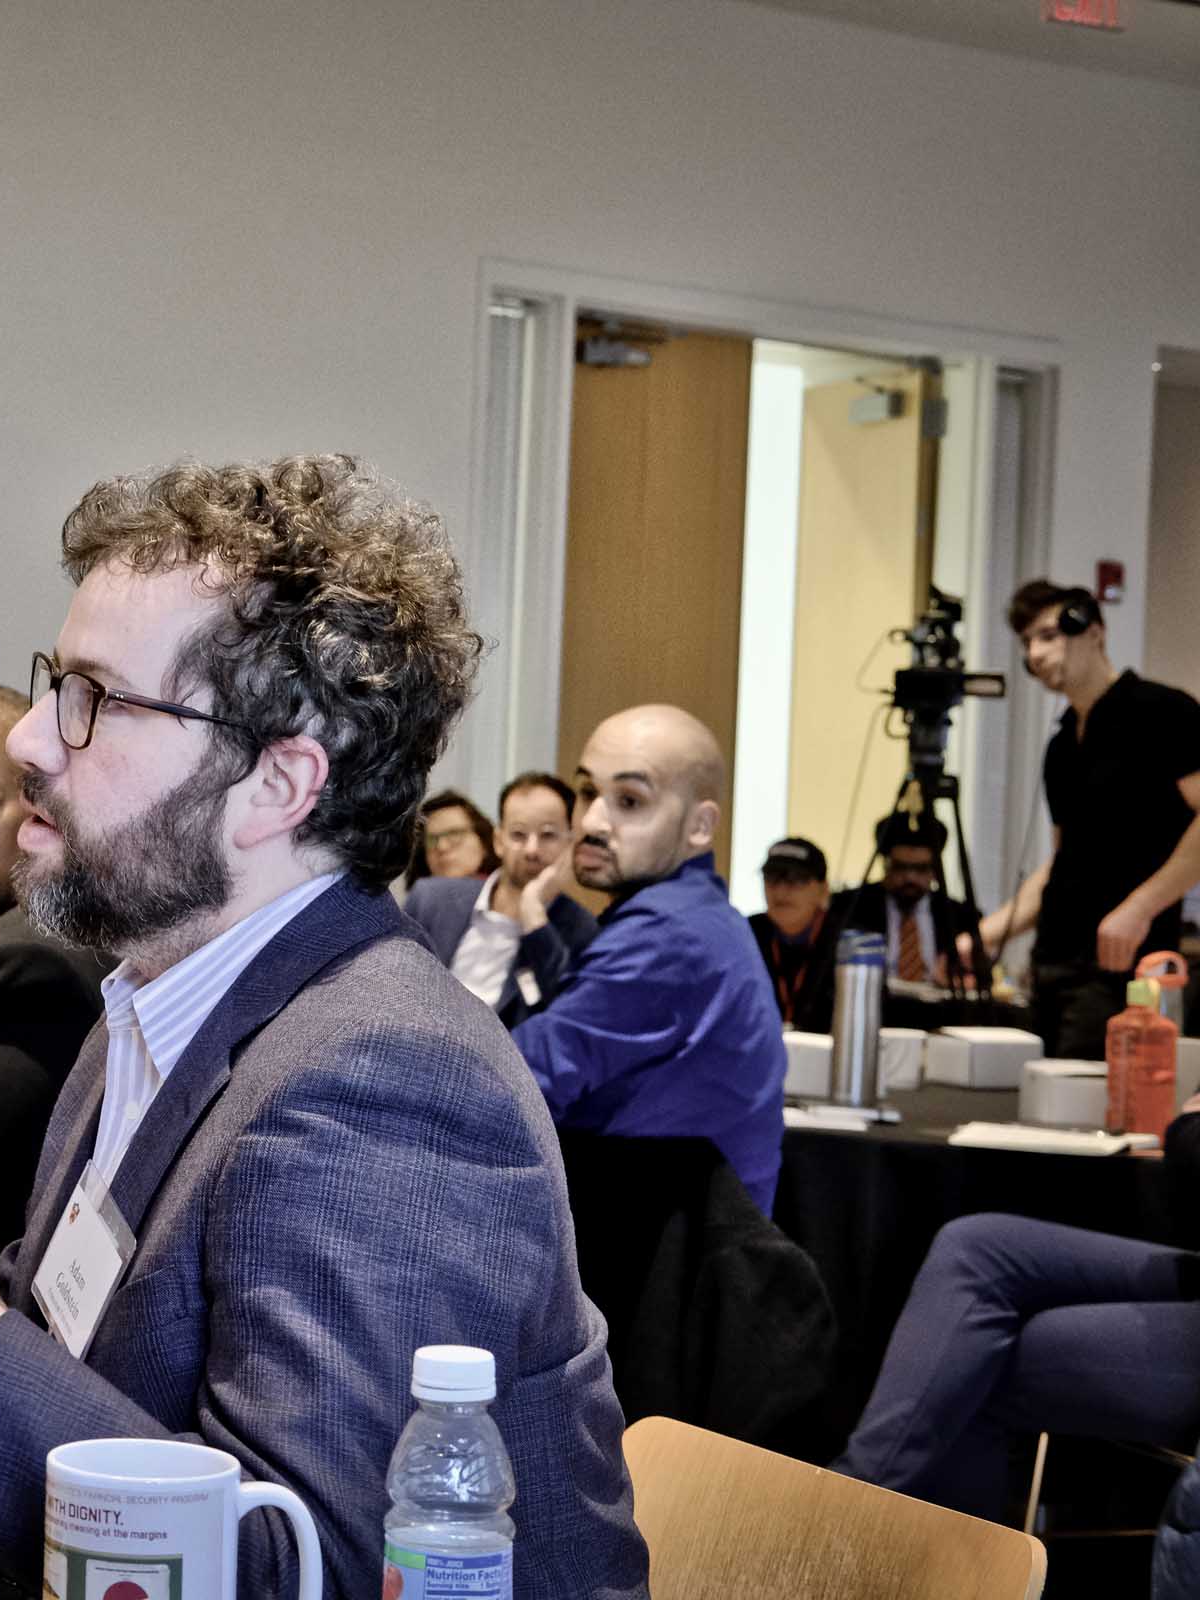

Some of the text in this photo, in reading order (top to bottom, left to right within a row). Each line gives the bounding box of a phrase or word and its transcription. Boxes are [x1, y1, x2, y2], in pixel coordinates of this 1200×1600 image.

[68, 1503, 124, 1526] DIGNITY.
[102, 1527, 111, 1537] at
[114, 1528, 128, 1539] the
[130, 1530, 168, 1541] margins
[427, 1568, 476, 1581] Nutrition
